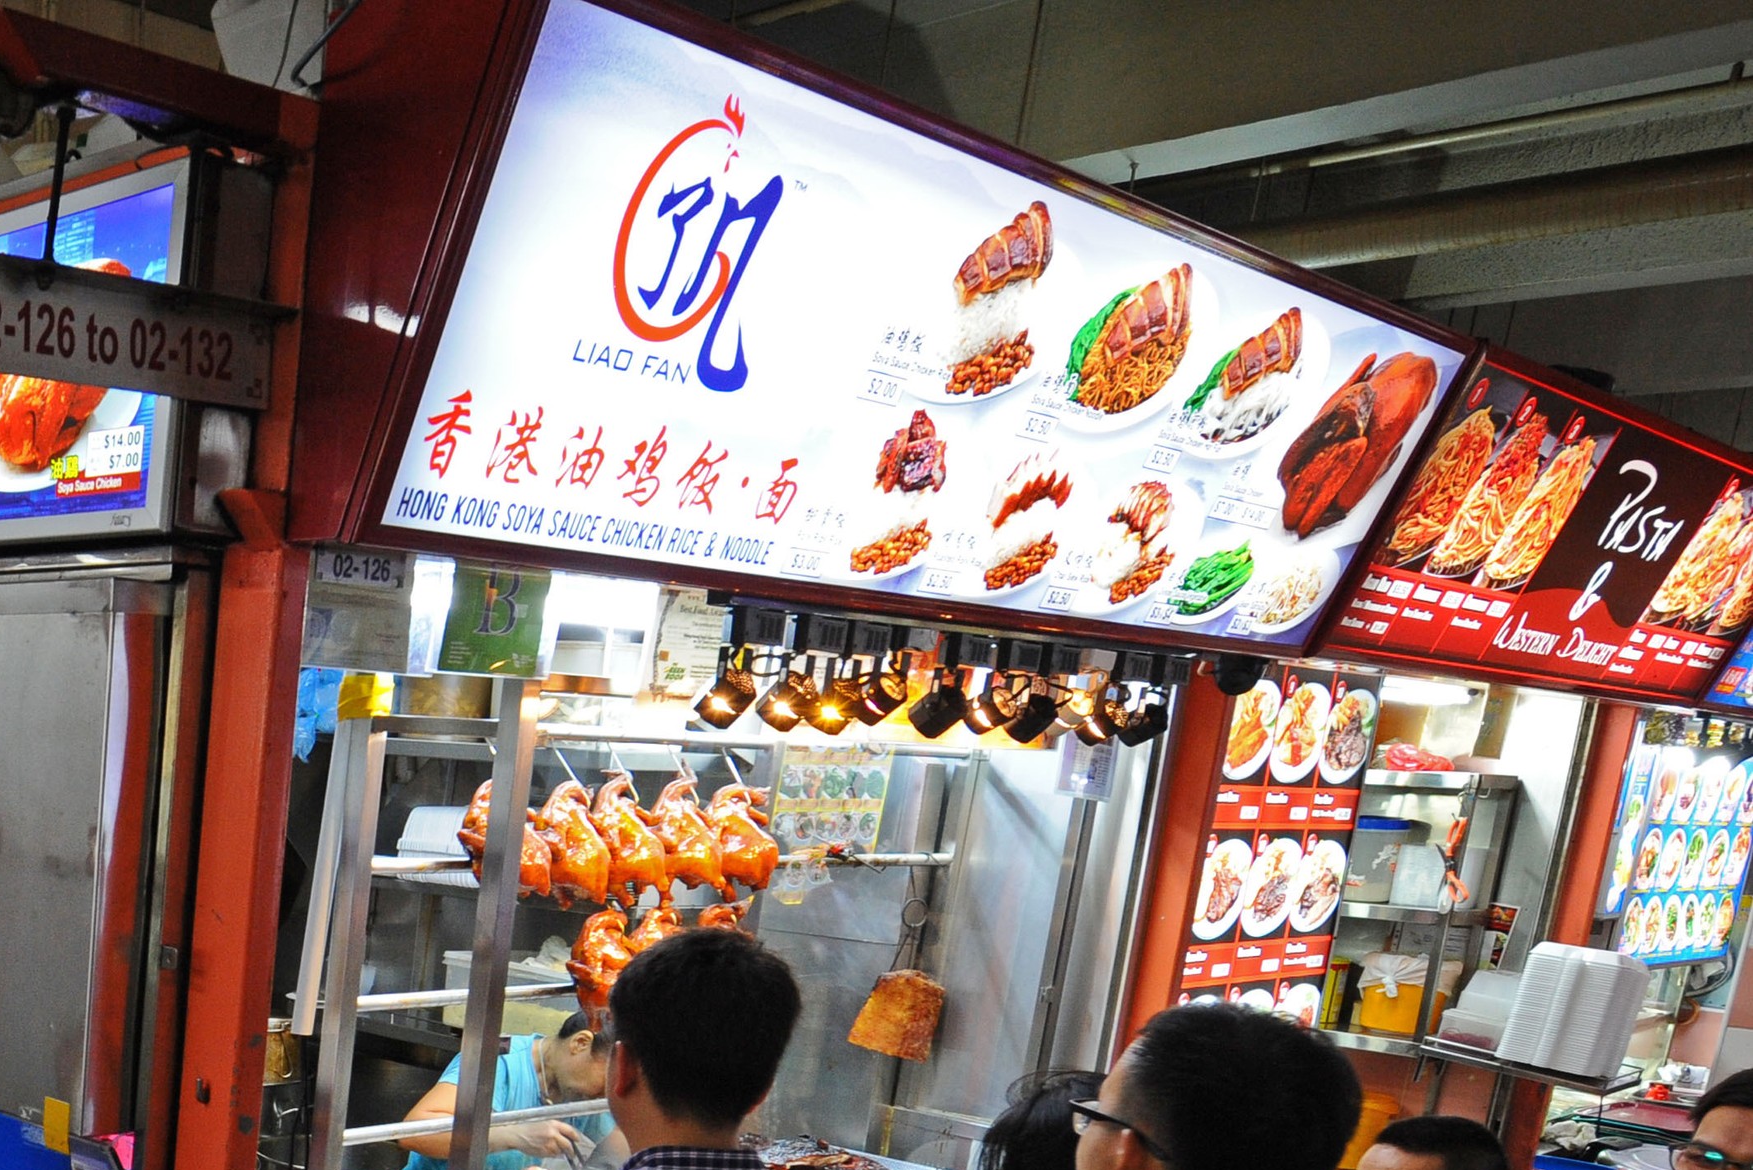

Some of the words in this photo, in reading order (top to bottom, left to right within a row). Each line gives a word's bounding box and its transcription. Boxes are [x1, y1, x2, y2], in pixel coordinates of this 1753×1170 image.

[86, 313, 119, 365] to
[130, 318, 233, 381] 02-132
[572, 339, 634, 371] LIAO
[641, 355, 691, 384] FAN
[104, 430, 141, 449] $14.00
[109, 452, 139, 469] $7.00
[57, 481, 74, 495] Soya
[75, 480, 94, 492] Sauce
[96, 477, 122, 490] Chicken
[396, 487, 449, 521] HONG
[451, 496, 498, 531] KONG
[502, 503, 544, 535] SOYA
[548, 510, 602, 543] SAUCE
[602, 518, 665, 551] CHICKEN
[666, 527, 701, 556] RICE
[705, 532, 717, 557] &
[719, 535, 775, 566] NOODLE
[332, 554, 390, 582] 02-126
[1493, 611, 1561, 655] WESTERN
[1556, 627, 1619, 665] DELIGHT
